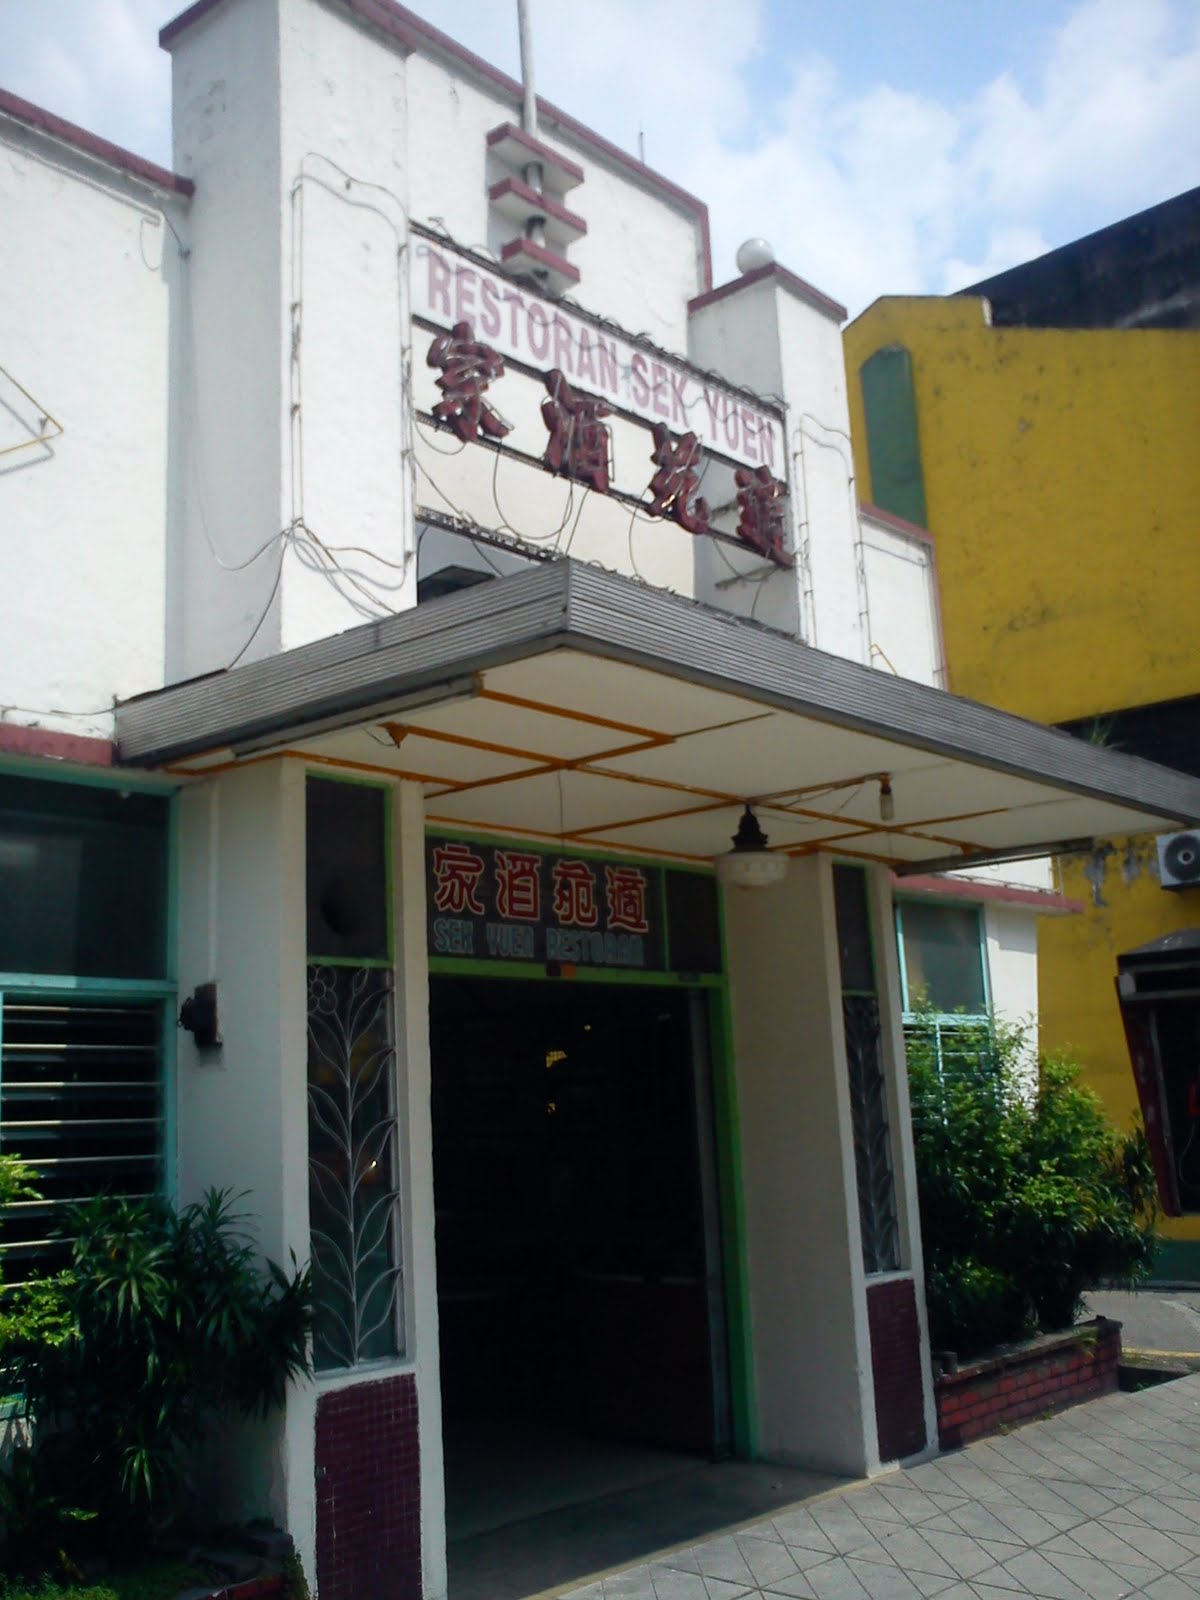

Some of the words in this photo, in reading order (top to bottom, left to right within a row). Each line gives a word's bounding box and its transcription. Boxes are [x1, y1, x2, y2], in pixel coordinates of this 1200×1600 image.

[427, 249, 618, 396] RESTORAN
[631, 352, 690, 429] SEK
[703, 379, 775, 469] YUEN
[433, 918, 474, 955] SEK
[486, 921, 535, 958] YUEN
